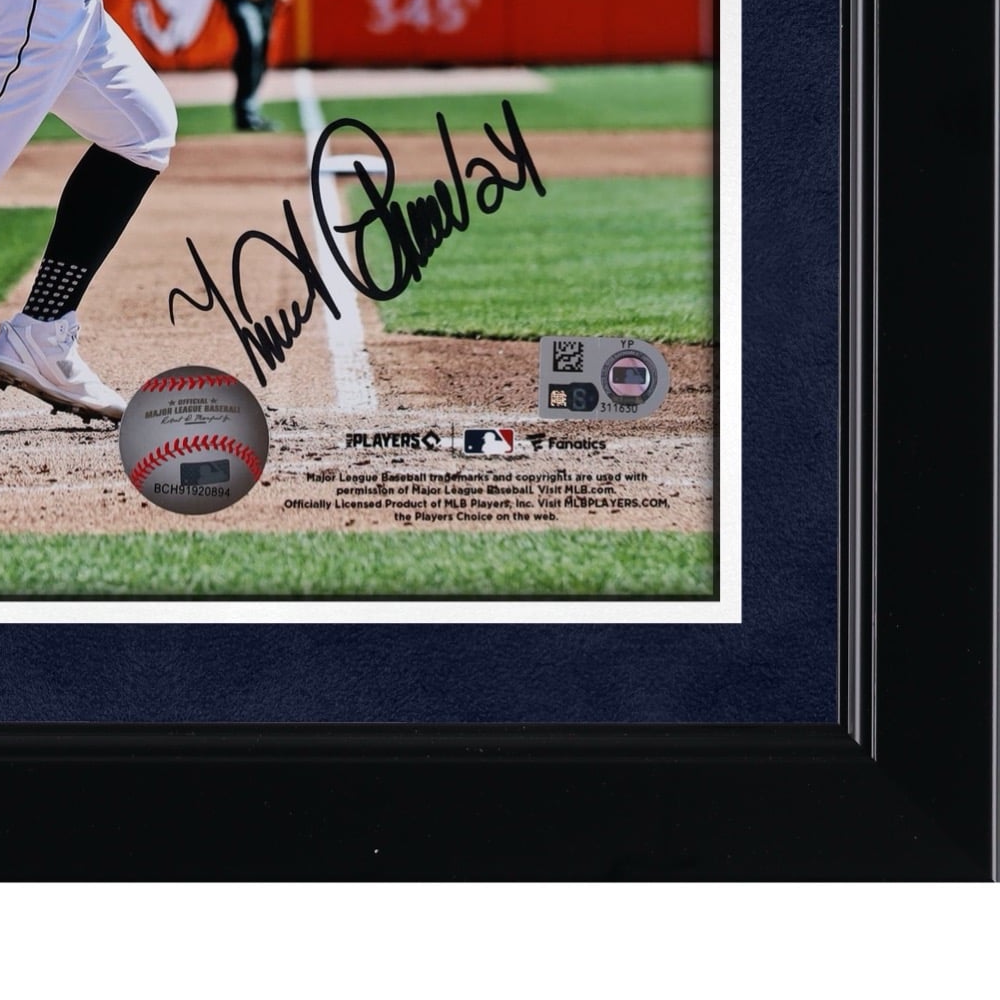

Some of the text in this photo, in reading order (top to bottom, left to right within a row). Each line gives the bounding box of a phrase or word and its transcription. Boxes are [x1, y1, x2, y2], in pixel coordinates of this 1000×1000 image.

[620, 340, 635, 348] YP
[177, 398, 209, 406] OFFICIAL
[144, 404, 241, 419] MAJOR LEAGUE BASEBALL
[353, 432, 421, 449] PLAYERS
[548, 437, 607, 450] Fanatics
[306, 472, 648, 484] Major League Baseball trademarks and copyrights are used with
[153, 482, 231, 498] BCH91920894
[336, 485, 394, 496] permission
[397, 485, 409, 495] of
[411, 485, 441, 497] Major
[444, 485, 483, 497] League
[537, 485, 561, 495] Visit
[564, 485, 617, 495] MLB.com.
[284, 498, 670, 510] Officially Licensed Product of MLB Players, Inc. Visit MLBPLAYERS.COM,
[394, 512, 559, 523] the Players Choice on the web.
